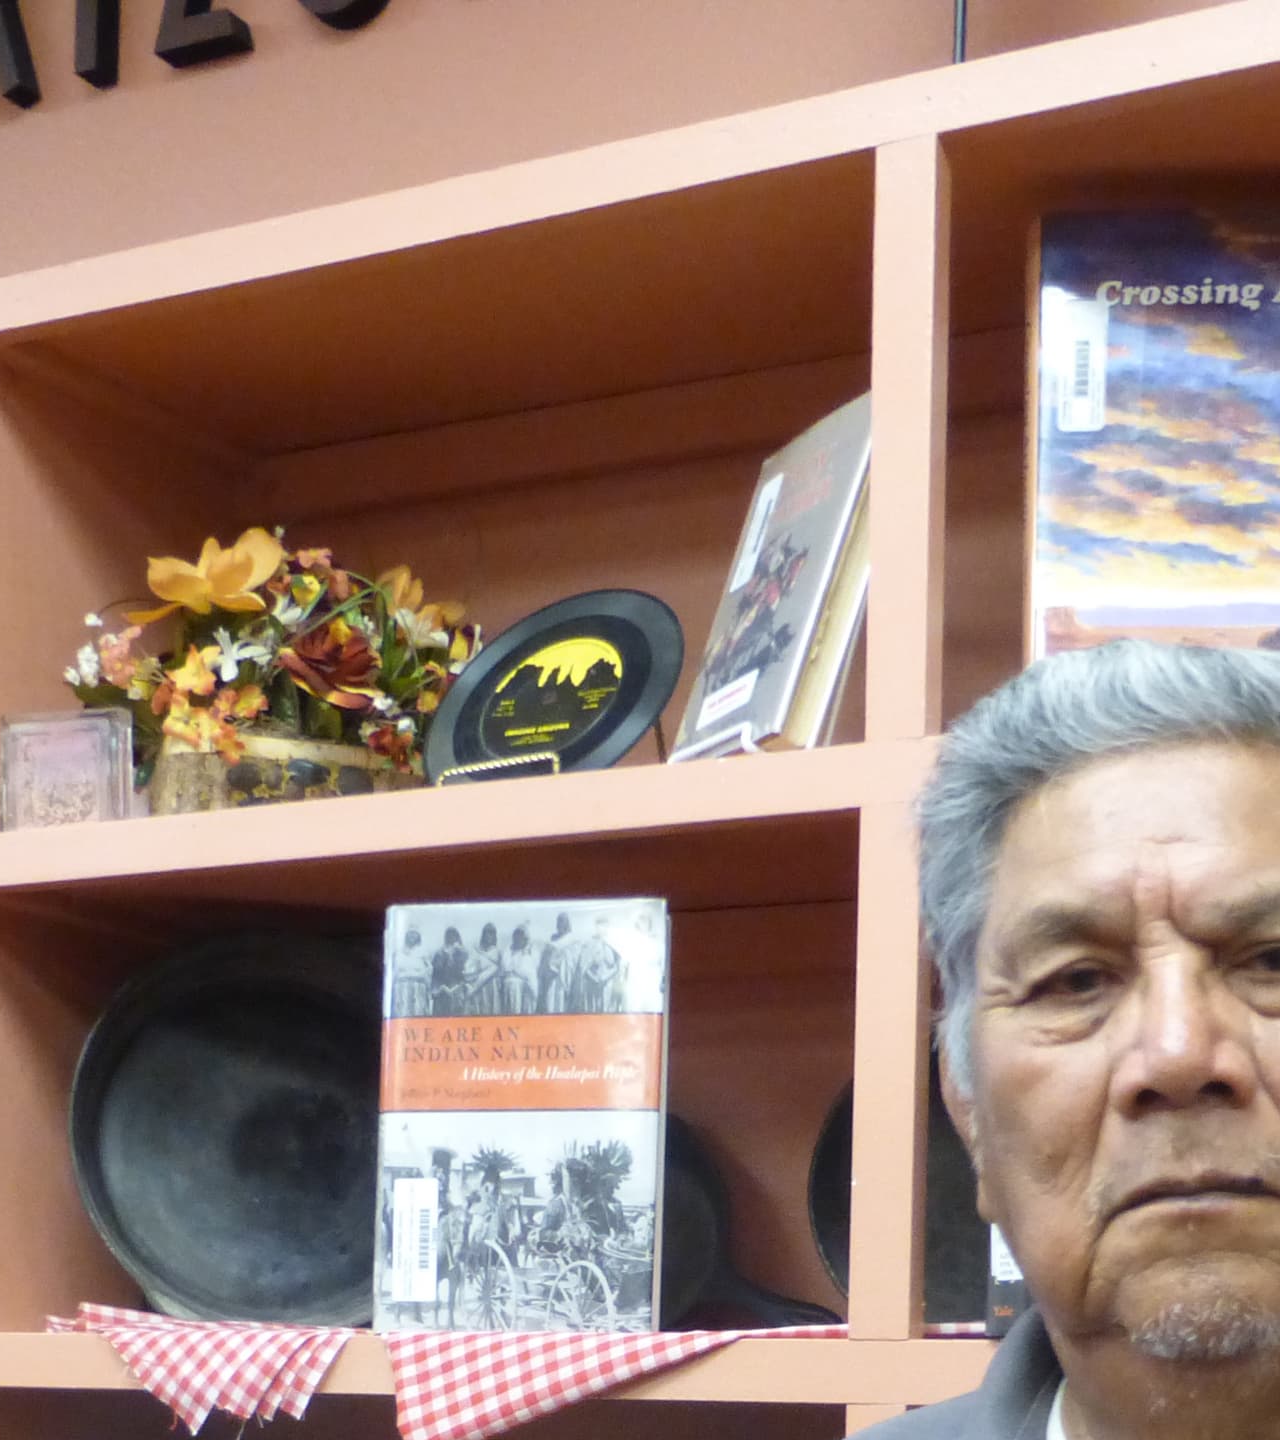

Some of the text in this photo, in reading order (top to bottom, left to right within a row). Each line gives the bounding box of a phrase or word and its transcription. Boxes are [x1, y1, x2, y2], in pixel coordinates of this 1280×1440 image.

[1095, 277, 1263, 309] Crossing
[404, 1025, 521, 1043] WE ARE AN
[403, 1044, 577, 1063] INDIAN NATION
[458, 1065, 601, 1085] A History of the Hualapai
